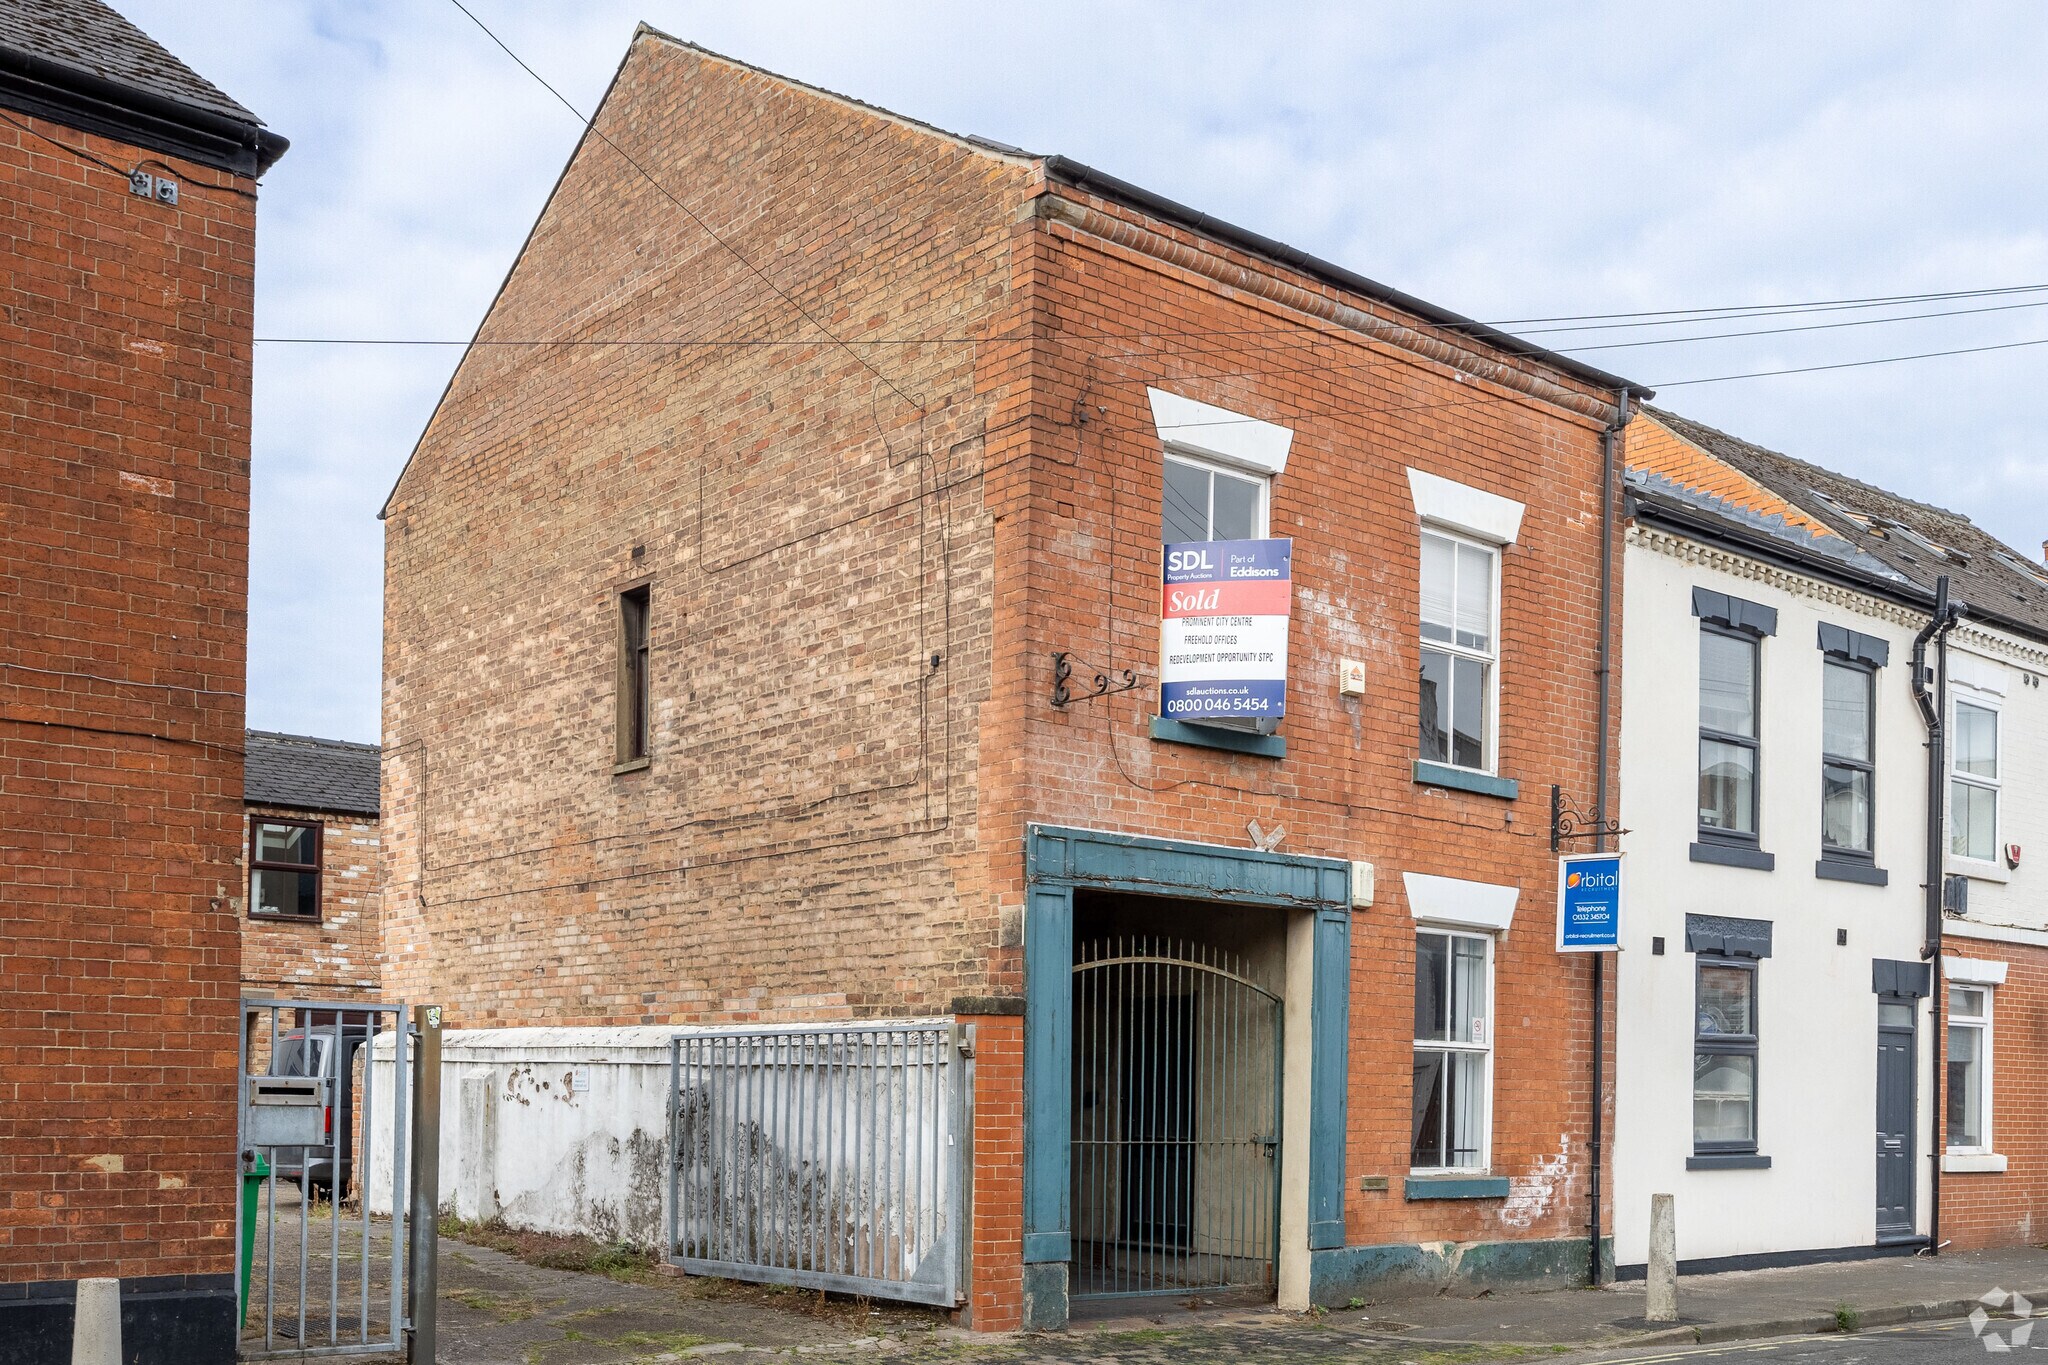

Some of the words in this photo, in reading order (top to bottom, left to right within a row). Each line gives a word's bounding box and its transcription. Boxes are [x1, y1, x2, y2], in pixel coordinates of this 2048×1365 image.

[1168, 550, 1213, 571] SDL
[1230, 555, 1246, 563] Part
[1247, 554, 1255, 563] of
[1230, 566, 1279, 577] Eddisons
[1167, 573, 1190, 581] Property
[1169, 588, 1221, 612] Sold
[1182, 617, 1214, 627] PROMINENT
[1215, 617, 1228, 627] CITY
[1230, 617, 1253, 627] CENTRE
[1184, 635, 1213, 645] FREEHOLD
[1214, 635, 1238, 645] OFFICES
[1169, 653, 1215, 664] REDEVELOPMENT
[1216, 652, 1257, 663] OPPORTUNITY
[1258, 652, 1274, 662] STPC
[1186, 686, 1249, 696] sdlauctions.co.uk
[1167, 699, 1202, 713] 0800
[1204, 698, 1231, 711] 046
[1233, 698, 1269, 711] 5454
